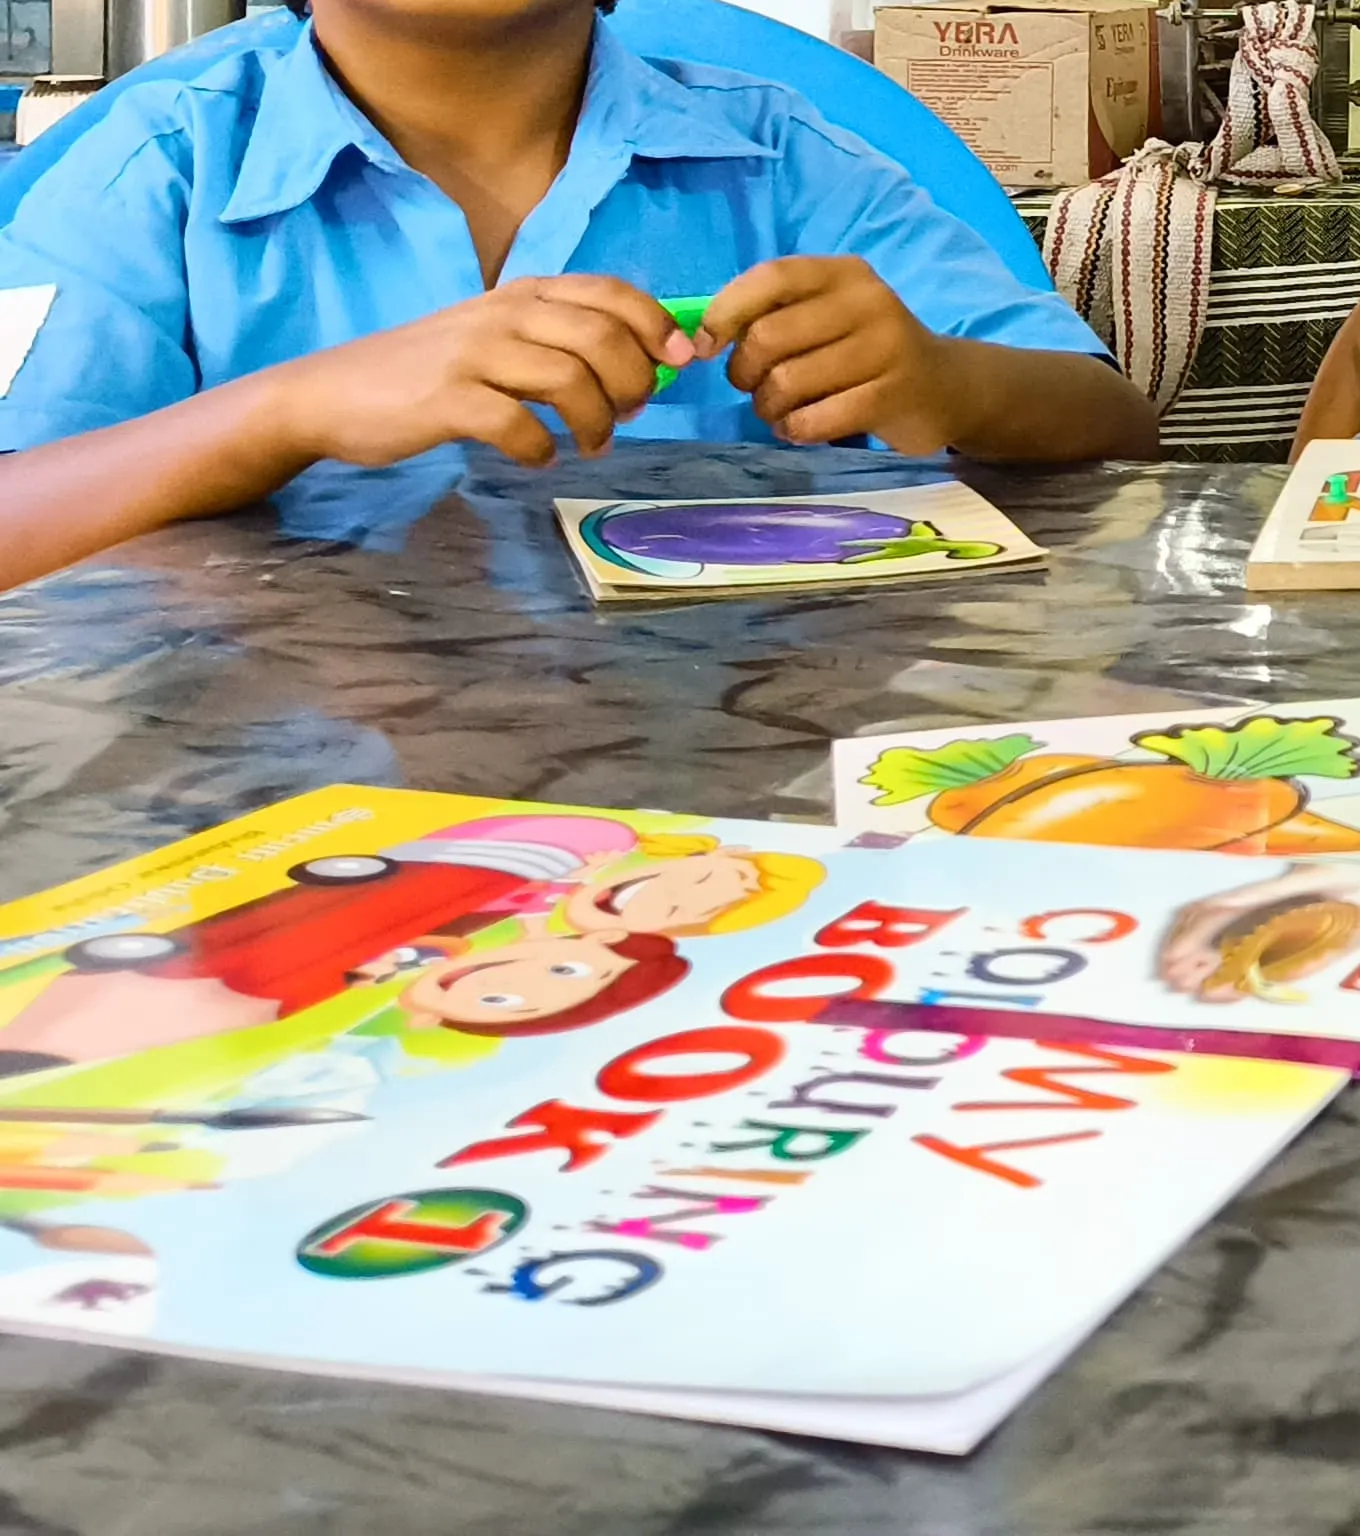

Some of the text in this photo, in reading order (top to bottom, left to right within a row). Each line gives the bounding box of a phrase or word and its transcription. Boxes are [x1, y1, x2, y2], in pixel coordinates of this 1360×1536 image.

[933, 21, 1020, 45] YERA
[939, 45, 1021, 59] Drinkware
[434, 898, 966, 1173] BOOK
[911, 1037, 1180, 1190] MY
